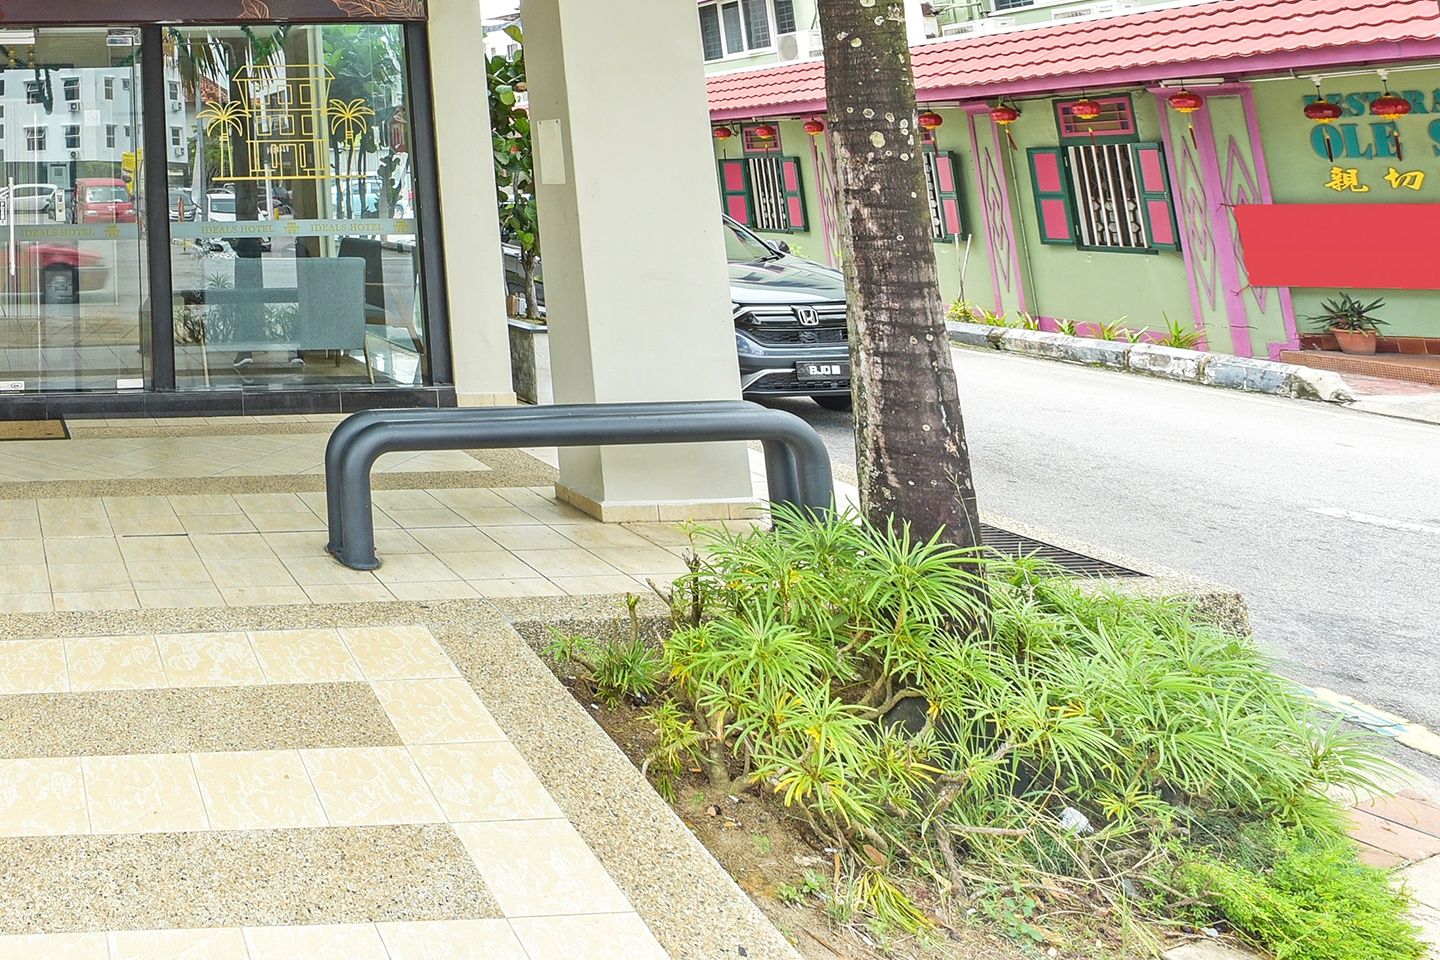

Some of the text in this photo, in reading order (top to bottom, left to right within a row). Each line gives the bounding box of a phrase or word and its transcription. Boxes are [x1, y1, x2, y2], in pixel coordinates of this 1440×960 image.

[1310, 122, 1404, 160] OLE
[1324, 166, 1426, 193] 親切
[201, 225, 275, 234] IDEALS HOTEL
[310, 223, 384, 232] IDEALS HOTEL
[21, 228, 95, 238] IDEALS HOTEL
